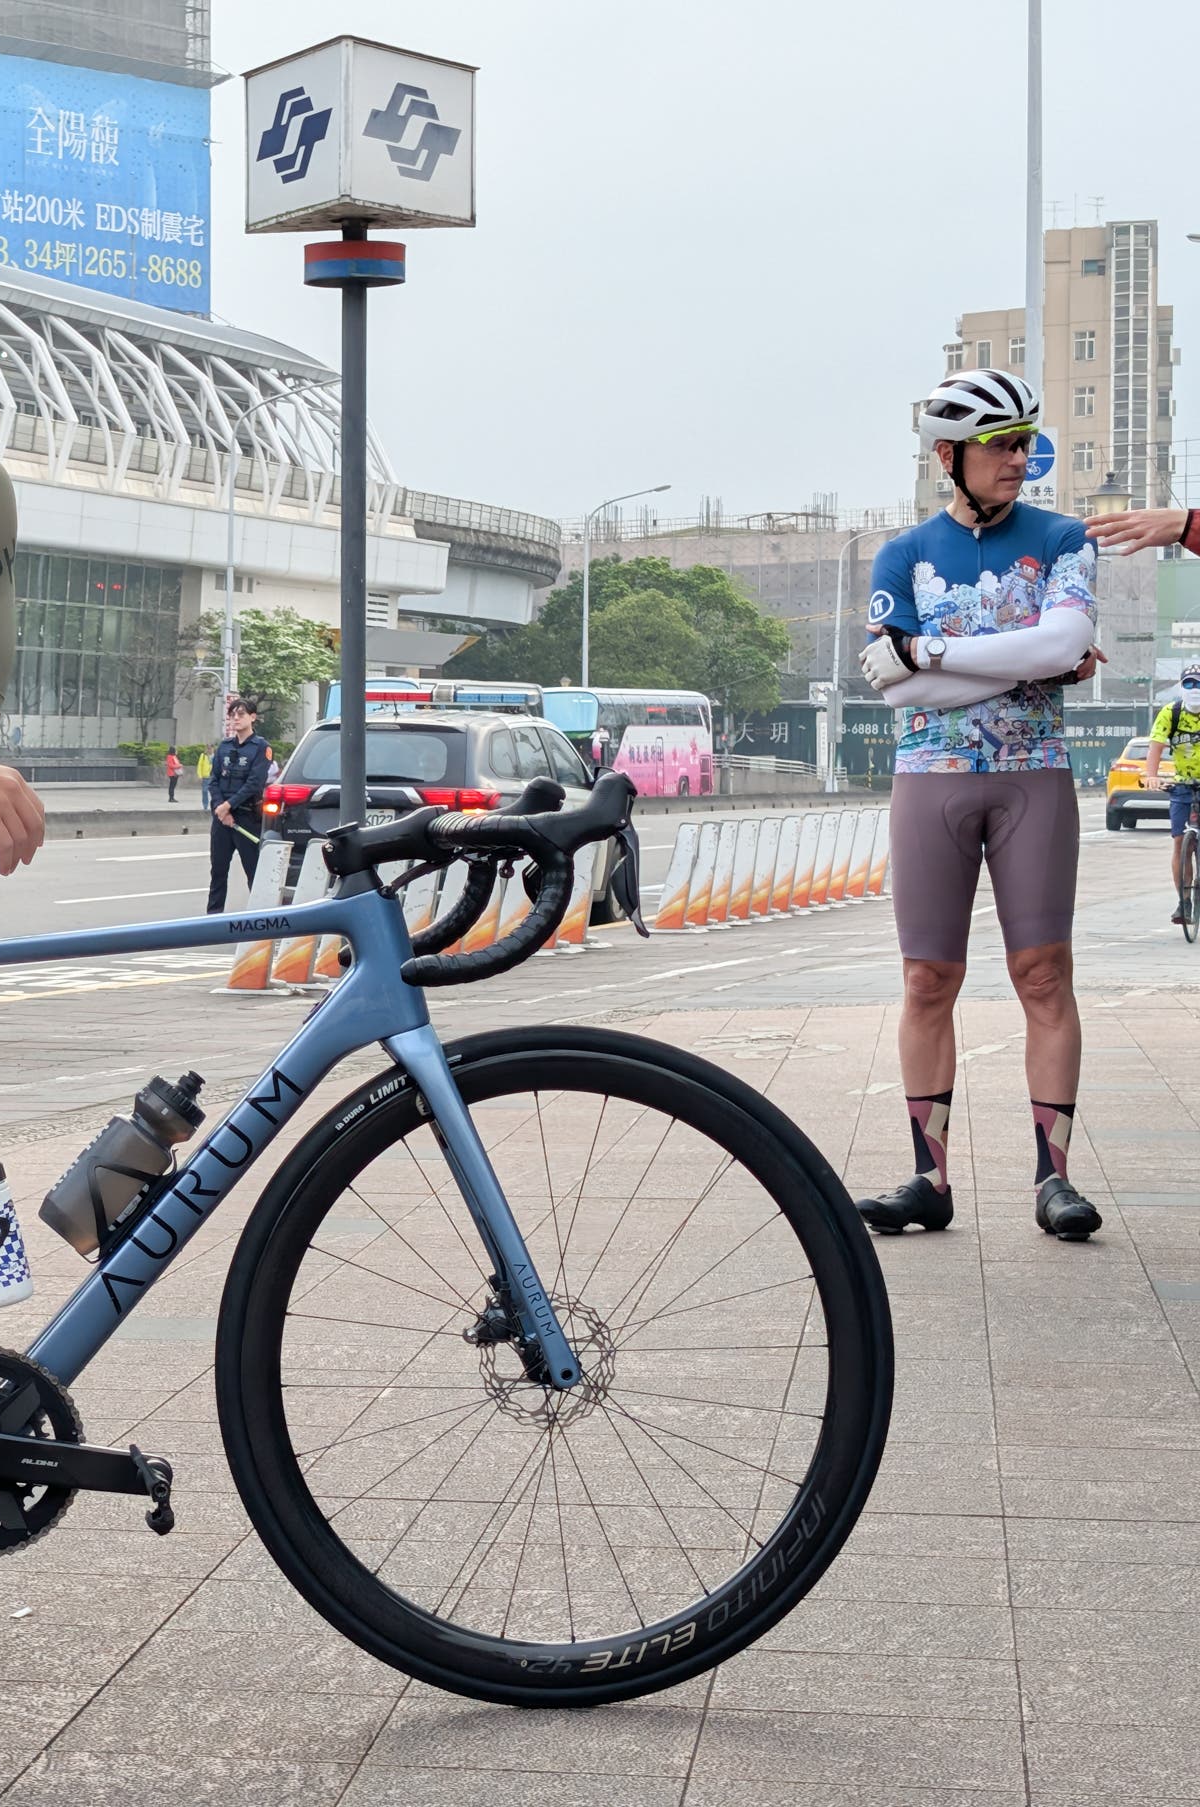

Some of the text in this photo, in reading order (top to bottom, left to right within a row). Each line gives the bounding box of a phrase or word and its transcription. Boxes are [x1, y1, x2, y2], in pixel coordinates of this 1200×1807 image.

[26, 106, 120, 167] 全陽馥
[95, 202, 205, 248] EDS制震宅
[229, 916, 291, 933] MAGMA
[343, 1104, 366, 1124] DURO
[100, 1066, 305, 1315] AURUM
[514, 1263, 557, 1337] AURUM
[707, 1493, 828, 1632] INFINITO
[580, 1621, 697, 1673] ELITE
